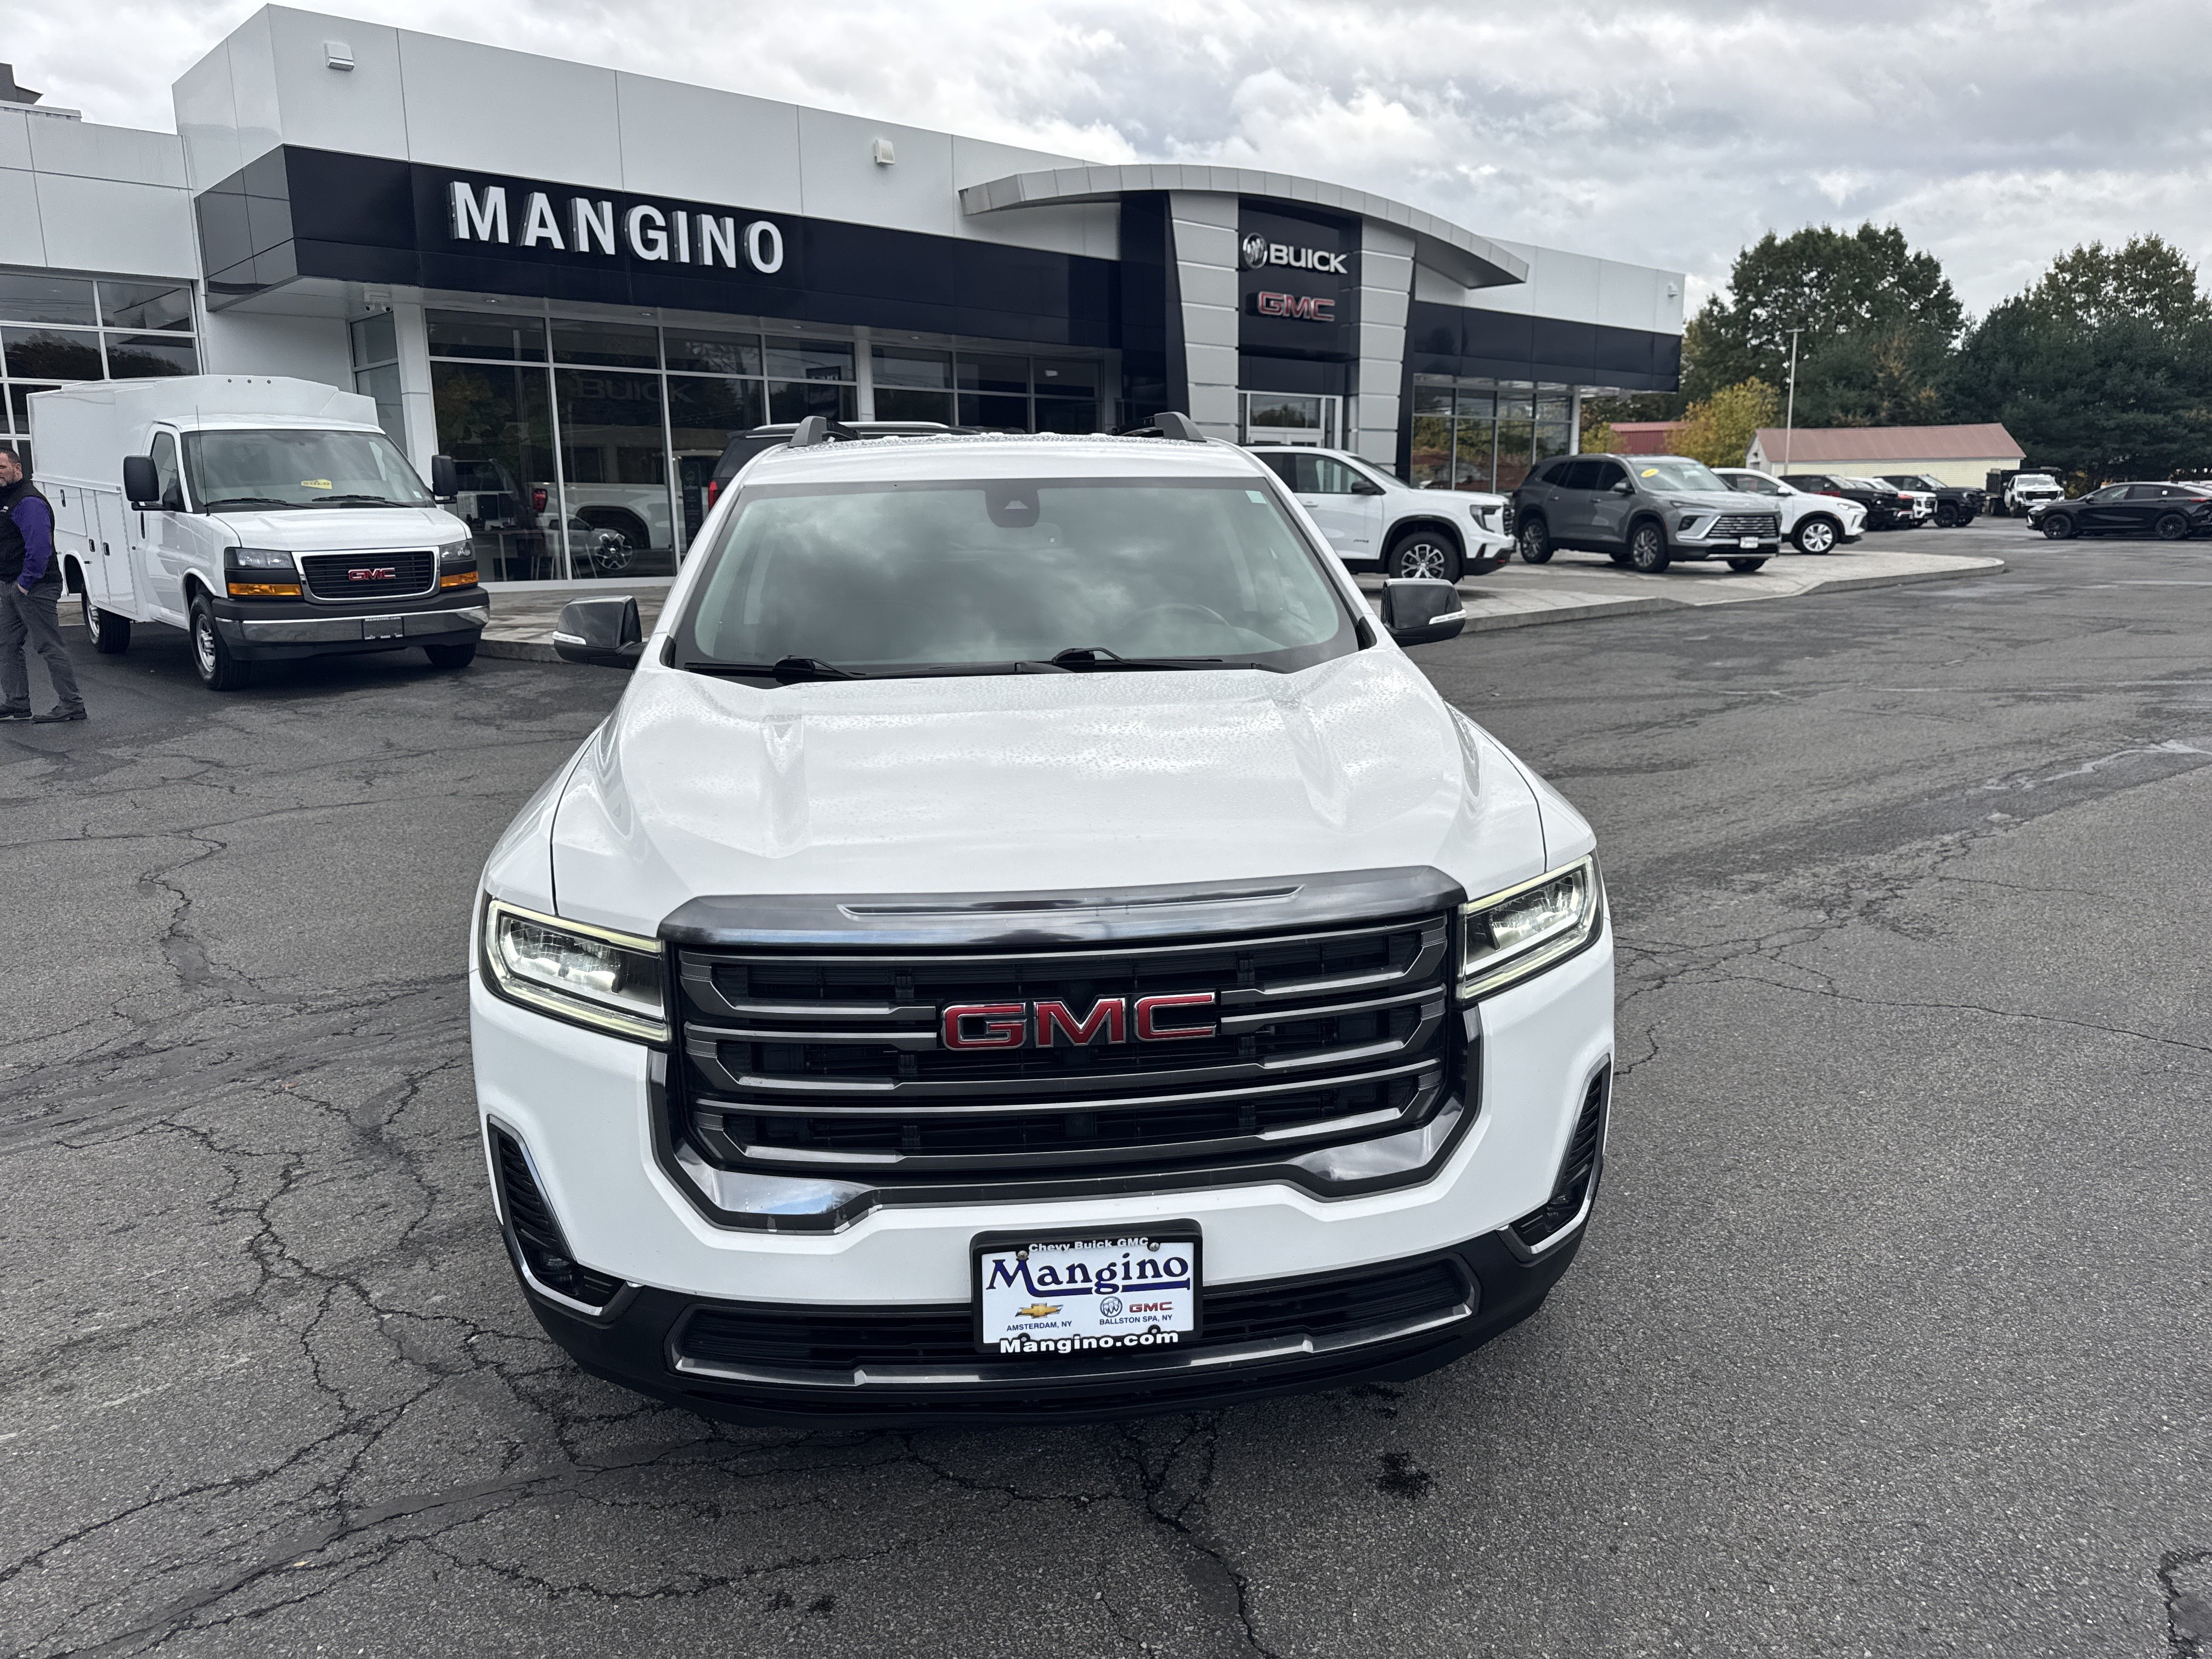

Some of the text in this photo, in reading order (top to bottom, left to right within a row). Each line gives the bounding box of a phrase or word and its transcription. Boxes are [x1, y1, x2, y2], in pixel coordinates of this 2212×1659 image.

[449, 181, 783, 273] MANGINO
[1269, 242, 1348, 274] BUICK
[1258, 291, 1335, 321] GMC
[574, 376, 695, 403] BUICK
[348, 567, 396, 580] GMC
[942, 992, 1216, 1051] GMC
[1028, 1237, 1149, 1252] Chevy Buick GMC
[986, 1252, 1190, 1297] Mangino
[1130, 1301, 1173, 1313] GMC
[1007, 1322, 1059, 1331] AMSTERDAM,
[1099, 1317, 1141, 1325] BALLSTON
[1000, 1330, 1179, 1353] Mangino.com
